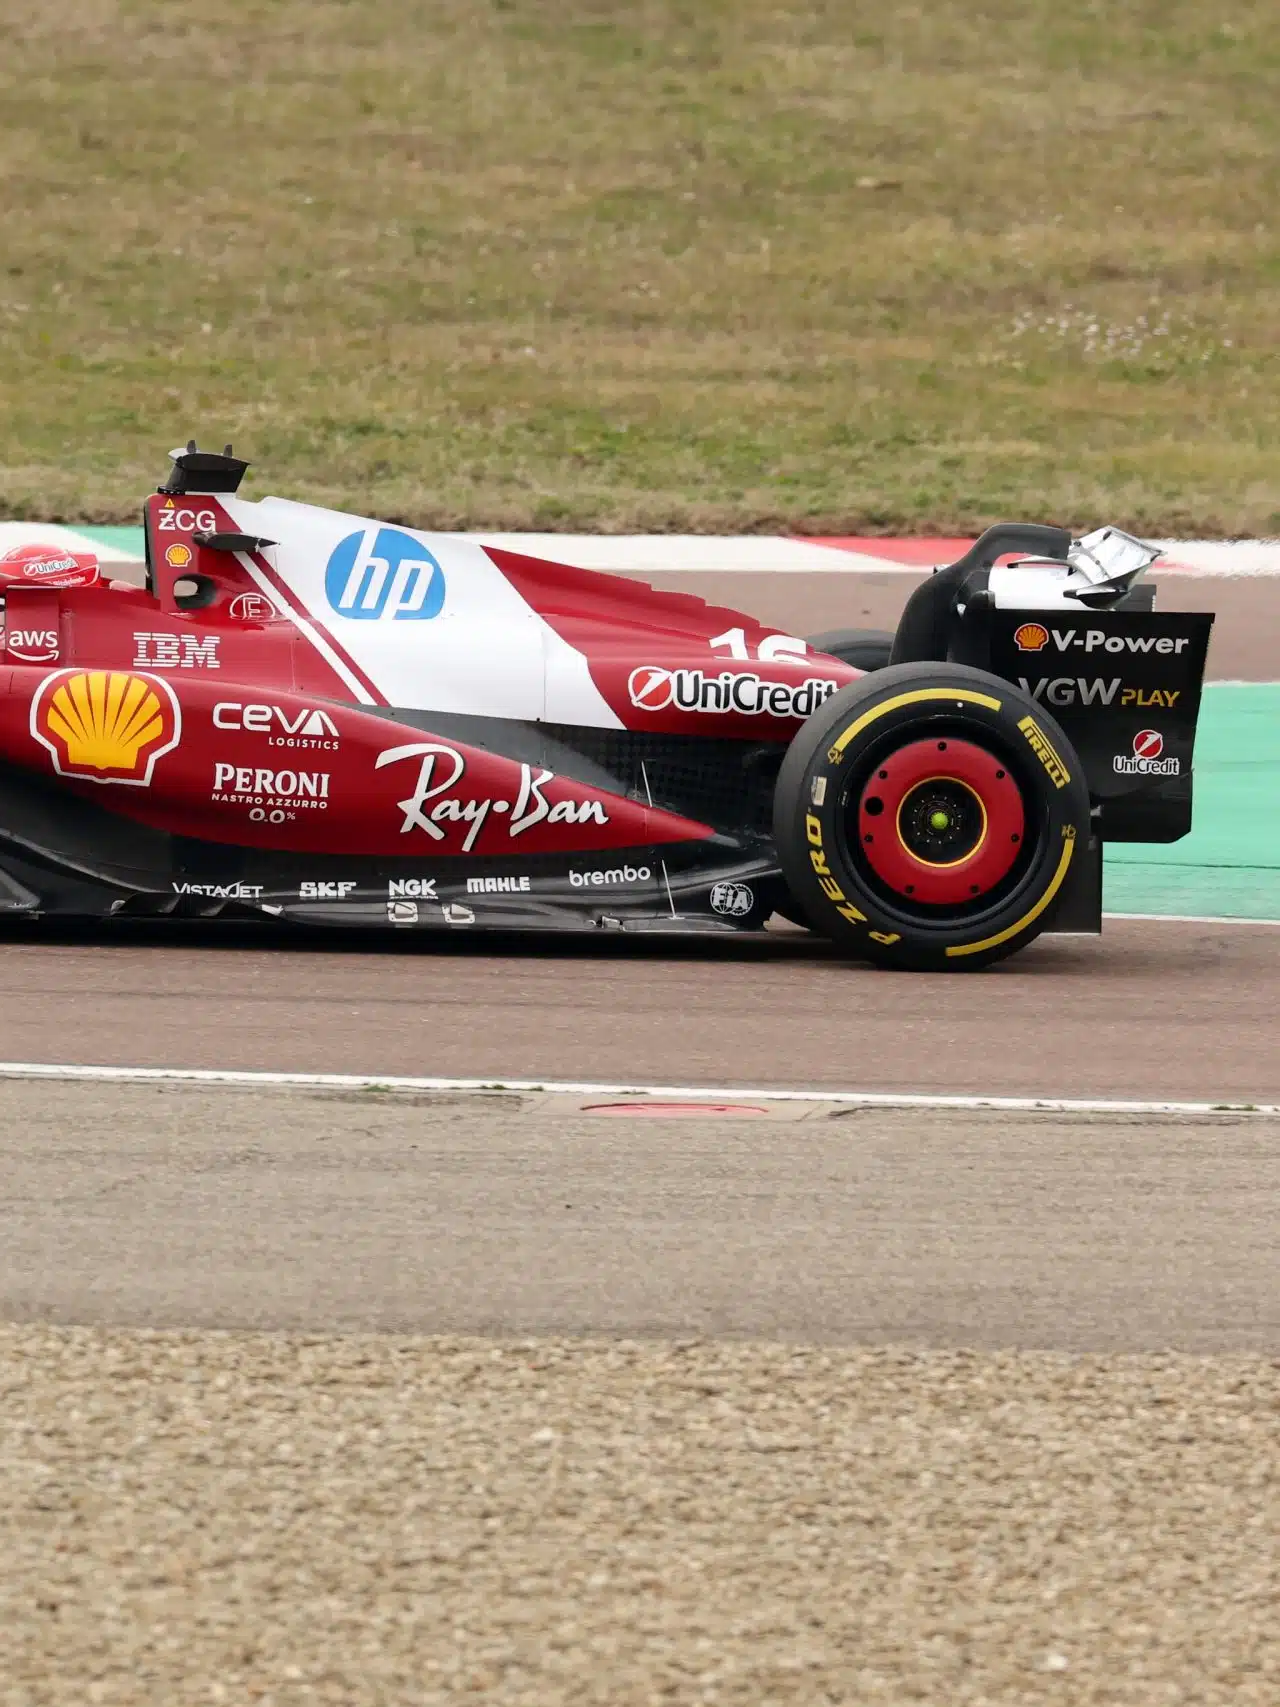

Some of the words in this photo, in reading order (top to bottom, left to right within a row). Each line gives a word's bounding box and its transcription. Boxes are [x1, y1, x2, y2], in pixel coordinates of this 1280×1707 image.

[338, 529, 435, 620] hp
[9, 631, 58, 648] aws
[133, 632, 220, 668] IBM
[1052, 630, 1189, 653] V-Power
[1018, 677, 1122, 706] VGW
[1122, 689, 1181, 708] PLAY
[269, 737, 339, 750] LOGISTICS
[1017, 715, 1071, 789] PIRELLI
[1114, 756, 1179, 775] UniCredit
[213, 763, 330, 798] PERONI
[212, 793, 263, 805] NASTRO
[267, 797, 328, 809] AZZURRO
[569, 865, 651, 887] brembo
[806, 814, 868, 925] ZERO
[300, 881, 357, 897] SKF
[389, 879, 437, 896] NGK
[467, 877, 531, 893] MAHLE
